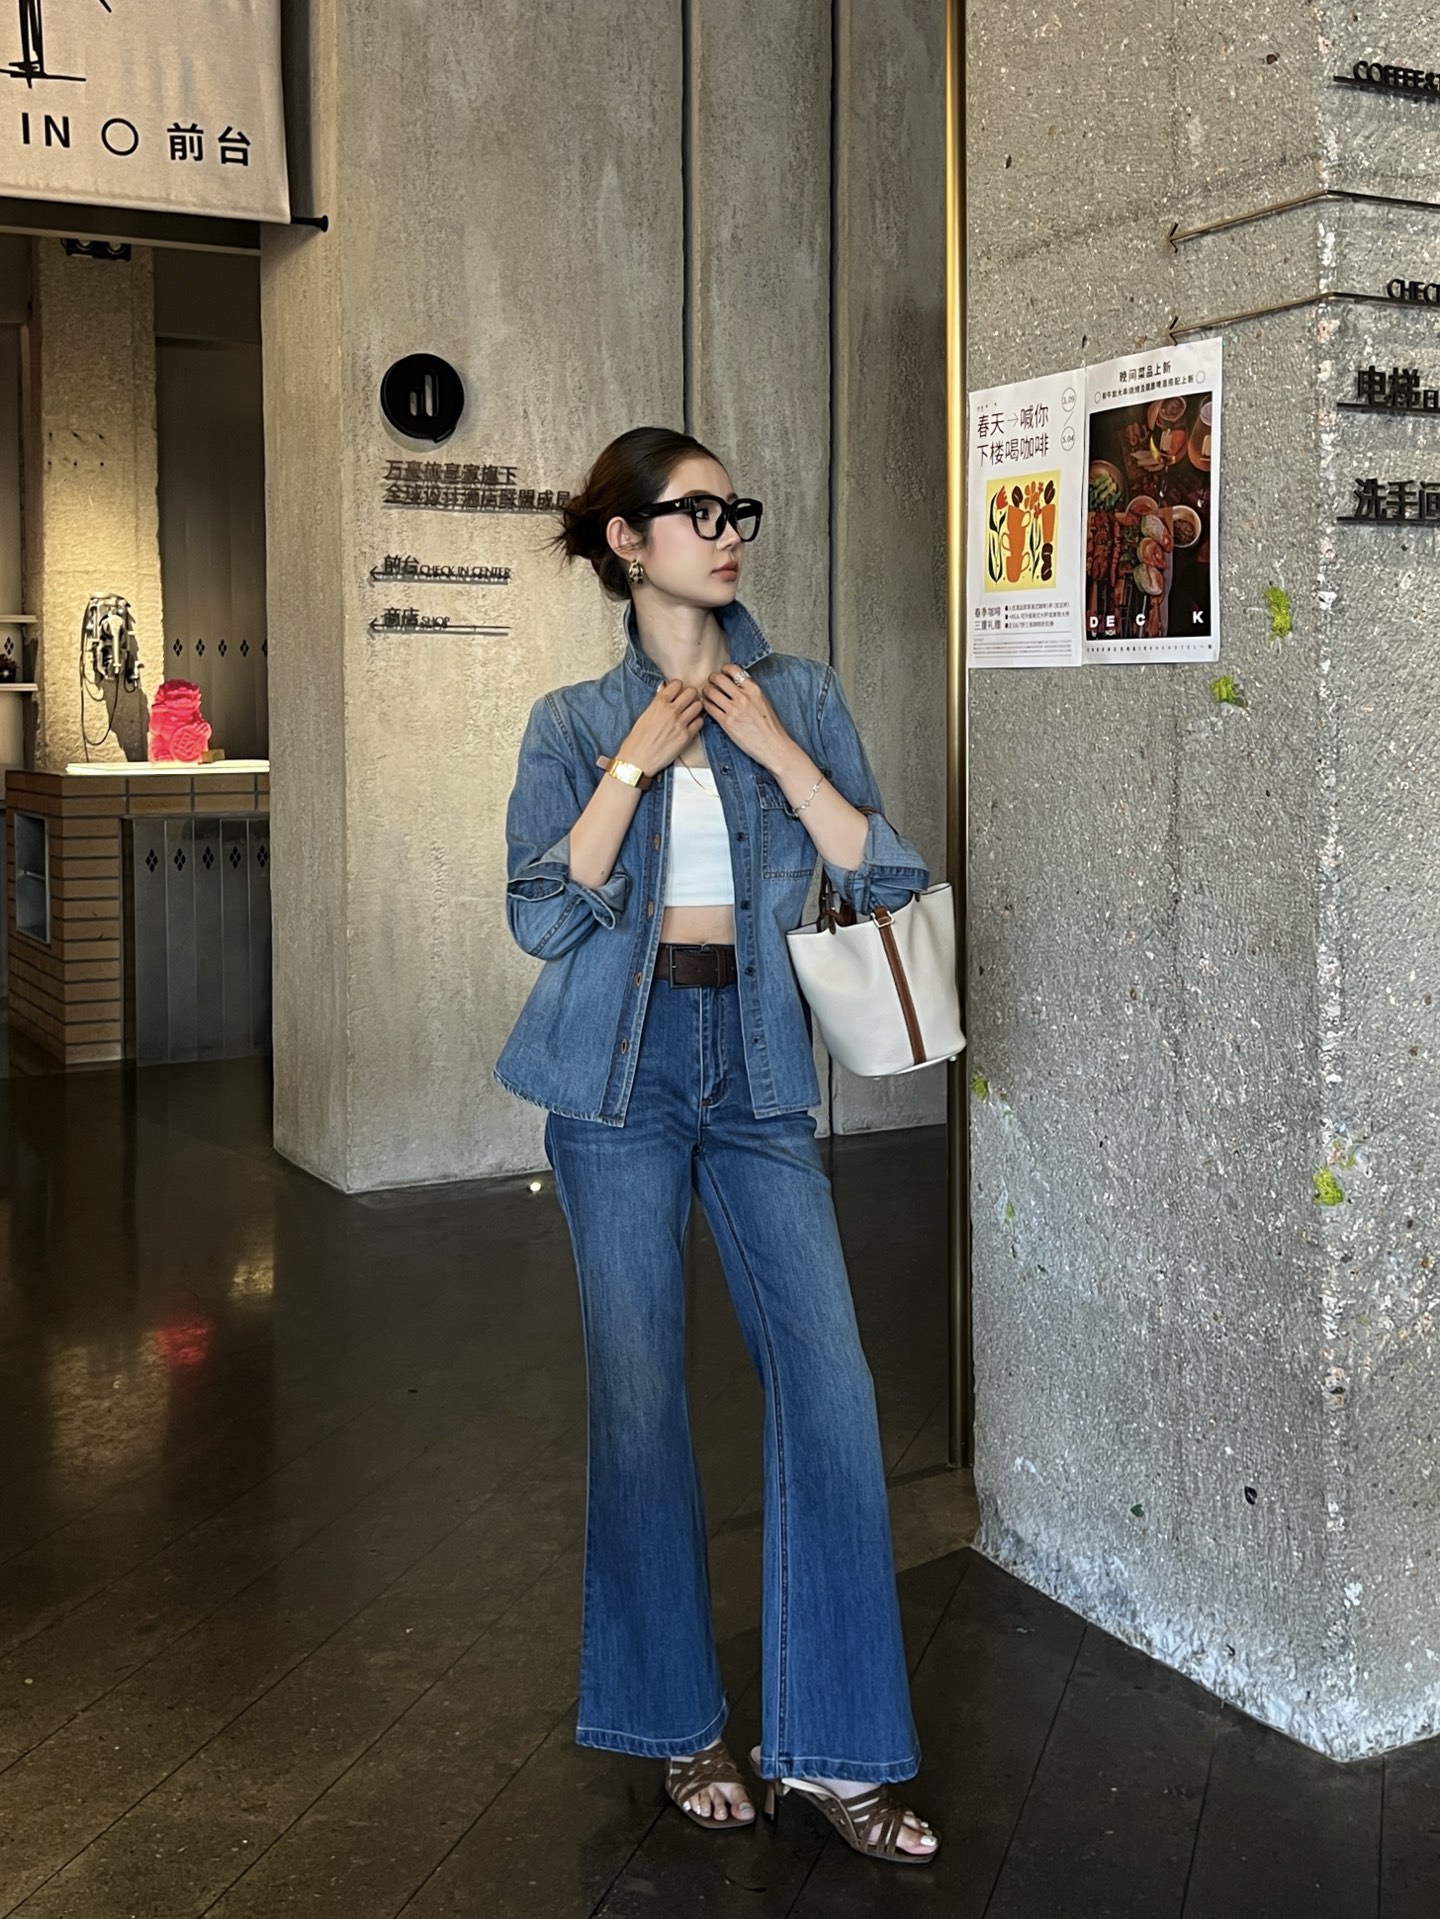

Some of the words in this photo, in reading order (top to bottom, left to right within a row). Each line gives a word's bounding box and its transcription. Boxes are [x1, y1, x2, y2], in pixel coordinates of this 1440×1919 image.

[22, 112, 71, 148] IN
[167, 122, 251, 167] 前台
[1119, 361, 1172, 383] 晚间菜品上新
[1357, 365, 1420, 408] 电梯
[977, 412, 1005, 438] 春天
[1020, 403, 1049, 430] 喊你
[977, 432, 1049, 467] 下楼喝咖啡
[1354, 477, 1440, 519] 洗手间
[384, 554, 419, 577] 前台
[420, 564, 454, 577] CHECK
[458, 566, 469, 578] IN
[472, 566, 511, 580] CENTER
[383, 607, 419, 627] 商店
[420, 615, 450, 628] SHOP
